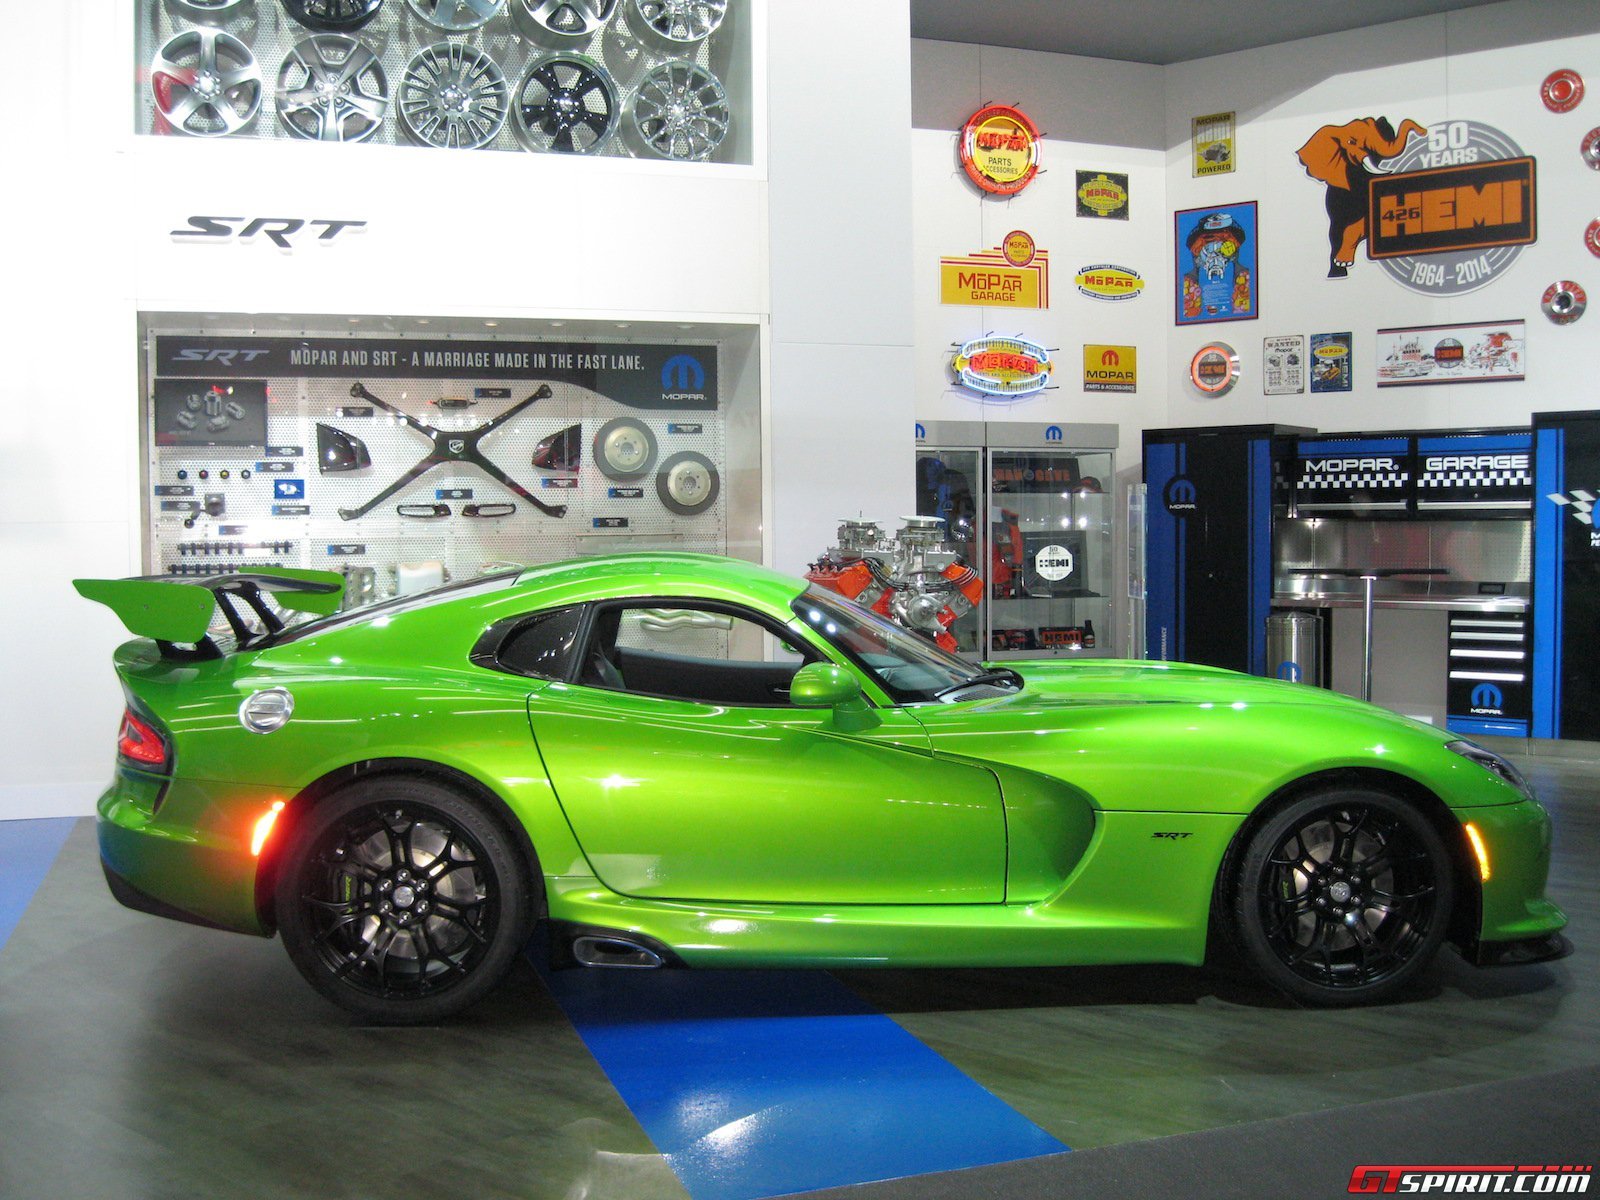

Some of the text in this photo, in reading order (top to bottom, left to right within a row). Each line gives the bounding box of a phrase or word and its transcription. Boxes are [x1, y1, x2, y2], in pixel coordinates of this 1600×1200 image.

[1427, 121, 1469, 151] 50
[988, 156, 1012, 167] PARTS
[1419, 147, 1478, 168] YEARS
[1197, 163, 1231, 174] POWERED
[1086, 189, 1119, 201] MOPAR
[1380, 179, 1523, 238] HEMI
[1381, 207, 1421, 221] 426
[170, 216, 368, 248] SRT
[1009, 241, 1029, 249] MOPAR
[958, 272, 1022, 292] MOPAR
[1085, 275, 1133, 288] MOPAR
[971, 290, 1016, 302] GARAGE
[1267, 340, 1301, 348] WANTED
[171, 349, 270, 366] SRT
[290, 349, 338, 366] MOPAR
[342, 350, 368, 366] AND
[372, 350, 397, 367] SRT
[411, 351, 420, 367] A
[424, 351, 490, 368] MARRIAGE
[494, 352, 530, 368] MADE
[533, 353, 547, 369] IN
[550, 353, 573, 369] THE
[577, 354, 607, 370] FAST
[611, 354, 645, 371] LANE.
[1086, 370, 1134, 379] MOPAR
[1425, 454, 1530, 472] GARAGE
[1039, 558, 1069, 568] HEMI
[1044, 633, 1080, 642] HEMI
[1151, 832, 1194, 841] SRT
